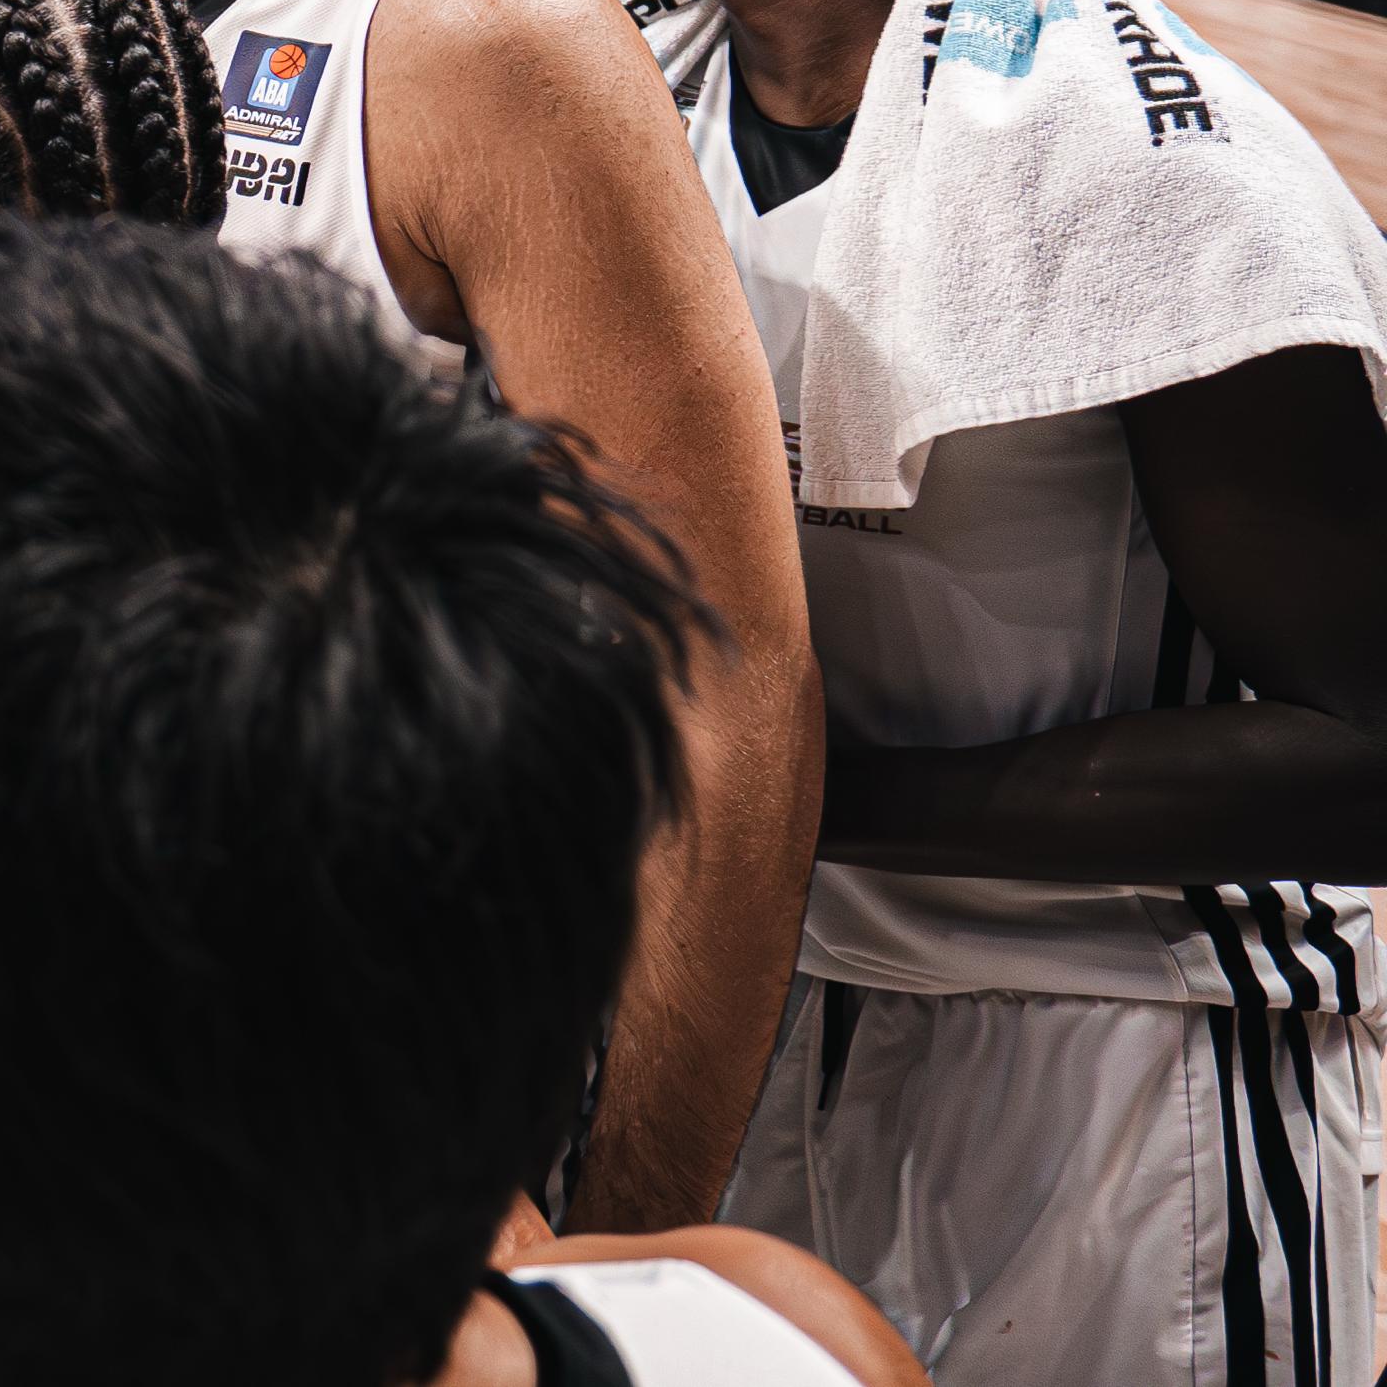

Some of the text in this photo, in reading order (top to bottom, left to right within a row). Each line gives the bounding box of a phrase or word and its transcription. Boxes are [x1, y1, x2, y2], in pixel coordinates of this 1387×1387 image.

[252, 77, 290, 107] ABA
[223, 105, 303, 132] ADMIRAL
[795, 501, 904, 536] BALL
